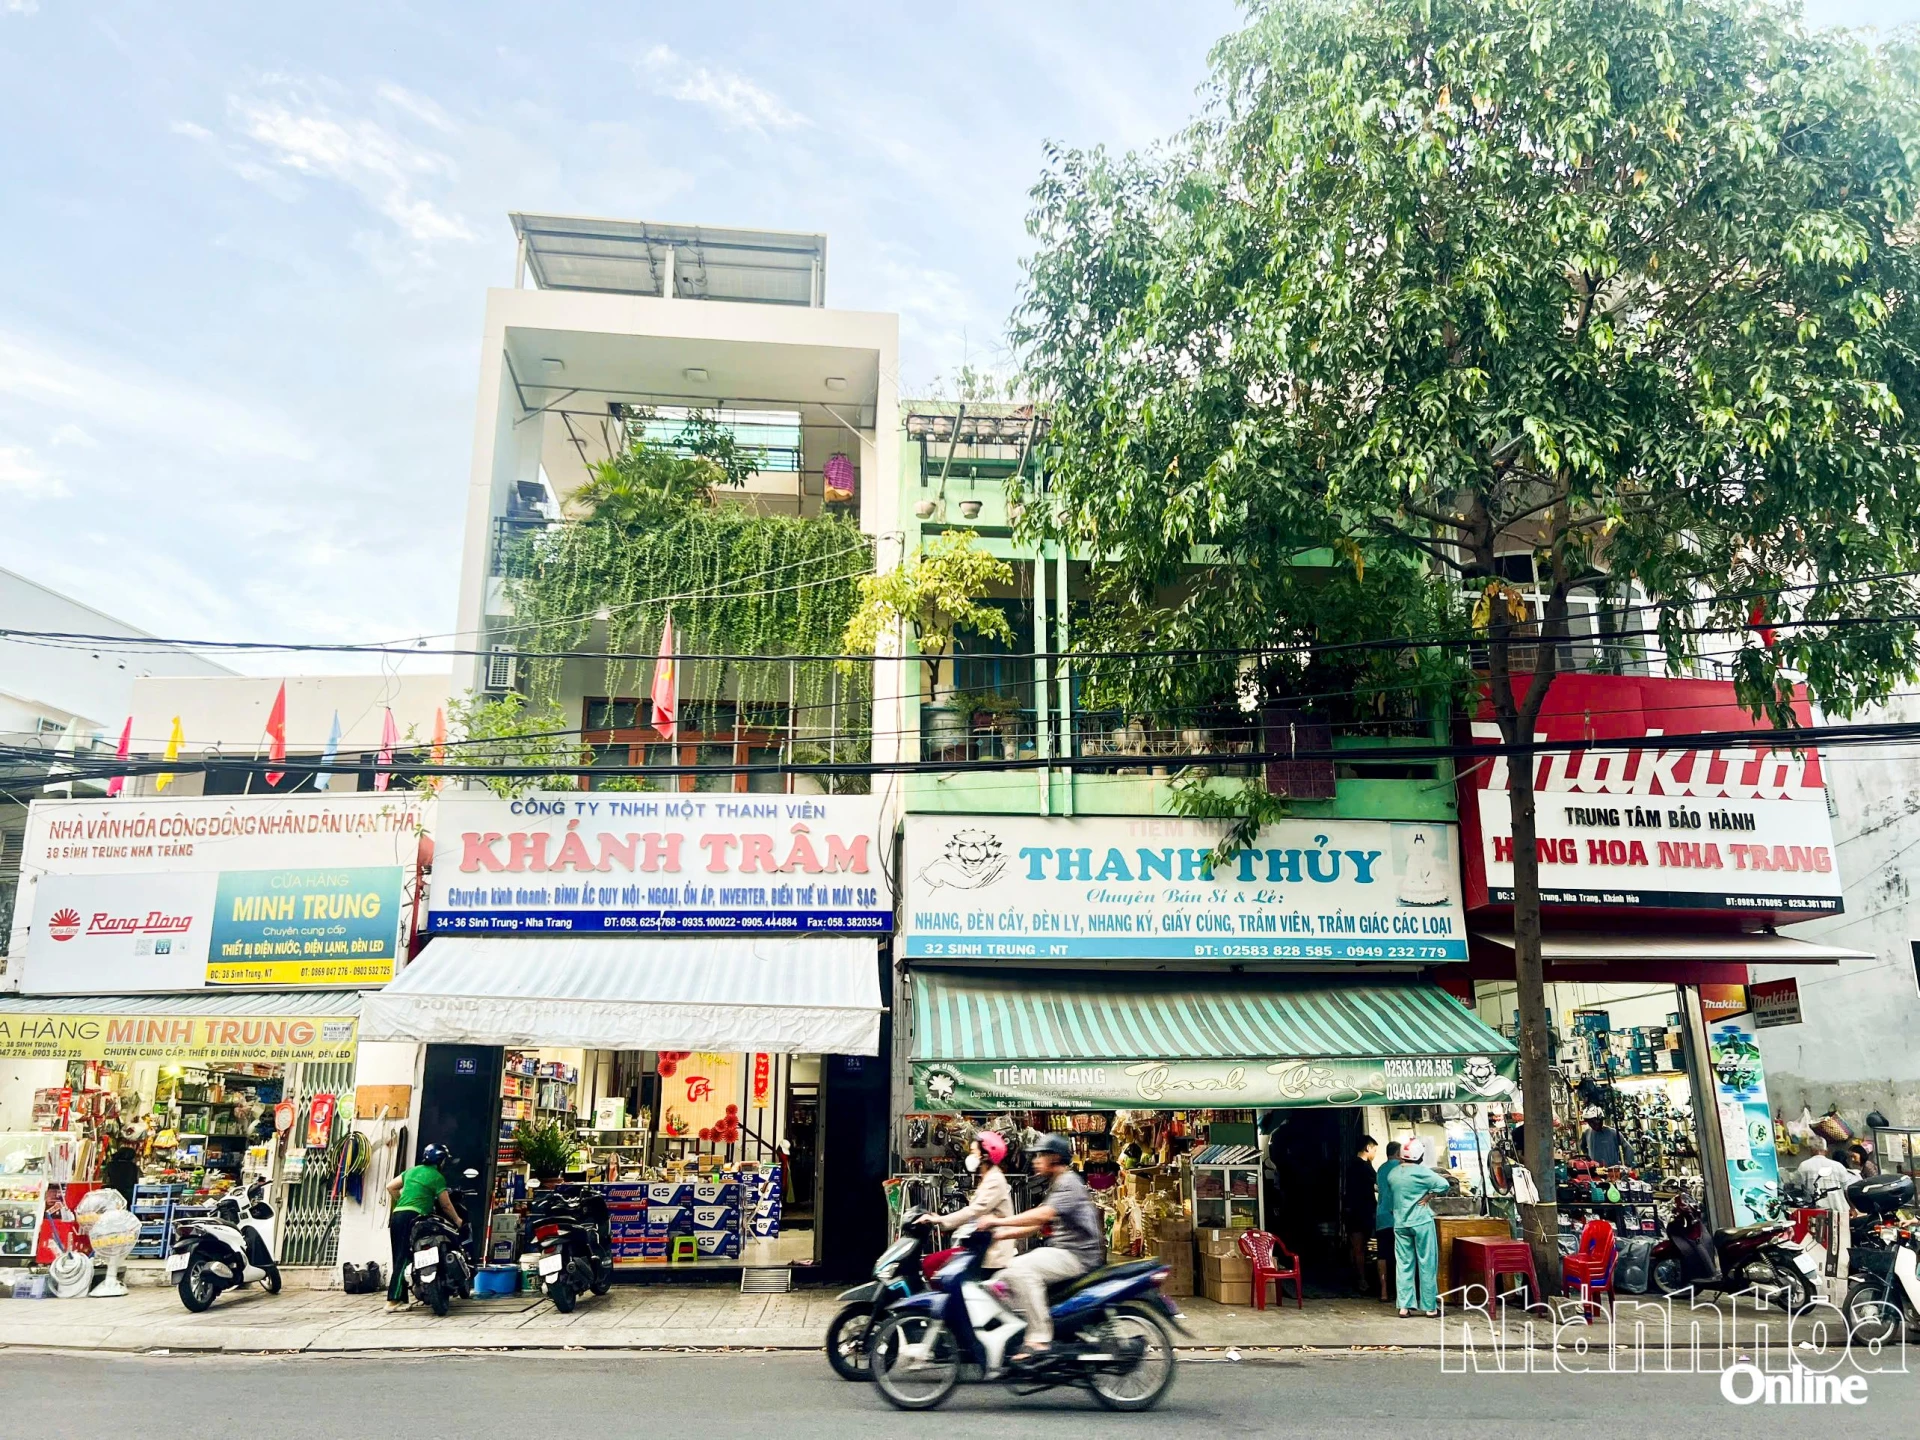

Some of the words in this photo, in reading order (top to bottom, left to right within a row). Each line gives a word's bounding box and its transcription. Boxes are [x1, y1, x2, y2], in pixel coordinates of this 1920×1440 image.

[510, 797, 565, 815] CÔNG
[576, 802, 599, 815] TY
[610, 802, 658, 816] TNHH
[665, 800, 706, 820] MỘT
[715, 803, 778, 818] THANH
[786, 800, 825, 819] VIÊN
[49, 813, 84, 839] NHÀ
[87, 811, 120, 839] VĂN
[122, 811, 157, 838] HÓA
[159, 812, 207, 843] CỘNG
[208, 806, 256, 836] ĐỒNG
[258, 809, 305, 835] NHÂN
[308, 809, 341, 833] DÂN
[345, 813, 377, 839] VẠN
[1564, 806, 1620, 827] TRUNG
[1624, 805, 1662, 828] TÂM
[1668, 805, 1701, 830] BẢO
[1708, 807, 1756, 831] HÀNH
[62, 846, 88, 858] SINH
[92, 846, 127, 858] TRUNG
[130, 845, 153, 857] NHA
[157, 845, 193, 857] TRANG
[459, 818, 684, 872] KHÁNH
[700, 822, 870, 874] TRÂM
[1492, 836, 1578, 864] HNG
[1585, 838, 1649, 866] HOA
[1656, 841, 1724, 869] NHA
[1729, 843, 1832, 873] TRANG
[1019, 847, 1215, 882] THANH
[1228, 834, 1382, 884] THỦY
[271, 872, 301, 888] CỬA
[306, 872, 349, 888] HÀNG
[448, 886, 487, 908] Chuyên
[491, 887, 513, 906] kinh
[516, 887, 551, 906] doanh:
[554, 883, 579, 905] BÌNH
[581, 880, 596, 905] ẮC
[599, 887, 618, 906] QUY
[622, 883, 640, 909] NỘI
[648, 887, 681, 909] NGOẠI,
[719, 887, 769, 907] INVERTER,
[771, 883, 789, 906] BIẾN
[796, 883, 815, 906] THẾ
[817, 884, 828, 906] VÀ
[832, 884, 853, 906] MÁY
[856, 887, 877, 909] SẠC
[1087, 888, 1156, 905] Chuyên
[1162, 887, 1202, 904] Bán
[1234, 892, 1245, 904] &
[1563, 893, 1577, 901] Nha
[232, 895, 295, 922] MINH
[303, 892, 381, 920] TRUNG
[468, 918, 489, 928] Sinh
[491, 918, 518, 930] Trung
[525, 918, 543, 928] Nha
[544, 918, 573, 930] Trang
[682, 918, 736, 927] 0935.100022
[742, 918, 797, 927] 0905.444884
[807, 918, 827, 927] Fax:
[915, 912, 963, 933] NHANG,
[967, 908, 997, 931] ĐÈN
[1032, 909, 1062, 932] ĐÈN
[1064, 914, 1084, 935] LY,
[1088, 914, 1132, 932] NHANG
[1162, 908, 1192, 933] GIẤY
[1196, 910, 1236, 936] CÚNG,
[1239, 907, 1277, 933] TRẦM
[1280, 911, 1315, 936] VIÊN,
[1318, 908, 1356, 934] TRẦM
[1359, 911, 1390, 934] GIÁC
[1393, 912, 1419, 934] CÁC
[1422, 917, 1452, 938] LOẠI
[263, 926, 299, 938] Chuyên
[301, 928, 325, 938] cung
[327, 925, 346, 937] cấp
[222, 939, 243, 956] THIẾT
[244, 943, 252, 959] BỊ
[254, 940, 273, 958] ĐIỆN
[304, 939, 323, 958] ĐIỆN
[325, 940, 349, 957] LẠNH,
[351, 937, 368, 953] ĐÈN
[370, 940, 384, 952] LED
[924, 944, 943, 954] 32
[948, 944, 982, 954] SINH
[987, 944, 1036, 955] TRUNG
[1050, 945, 1069, 955] NT
[1194, 945, 1219, 956] ĐT:
[1222, 945, 1269, 956] 02583
[1273, 945, 1301, 956] 828
[1305, 946, 1333, 957] 585
[1346, 946, 1383, 957] 0949
[1389, 947, 1415, 958] 232
[1420, 947, 1447, 958] 779
[231, 969, 243, 978] Sinh
[265, 969, 272, 978] NT
[338, 967, 348, 976] 276
[354, 967, 367, 975] 0903
[369, 966, 379, 975] 532
[380, 966, 390, 975] 725
[1703, 999, 1746, 1009] makita
[20, 1018, 100, 1040] HÀNG
[106, 1019, 194, 1044] MINH
[205, 1020, 316, 1046] TRUNG
[104, 1047, 137, 1056] CHUYÊN
[140, 1048, 163, 1056] CUNG
[189, 1047, 209, 1057] THIẾT
[336, 1051, 350, 1059] LED
[992, 1065, 1037, 1088] TIỆM
[1043, 1068, 1106, 1086] NHANG
[1384, 1059, 1453, 1078] 02583.828.585
[1386, 1082, 1456, 1101] 0949.232.779
[653, 1188, 670, 1197] GS
[698, 1188, 715, 1196] GS
[698, 1212, 715, 1221] GS
[698, 1237, 715, 1246] GS
